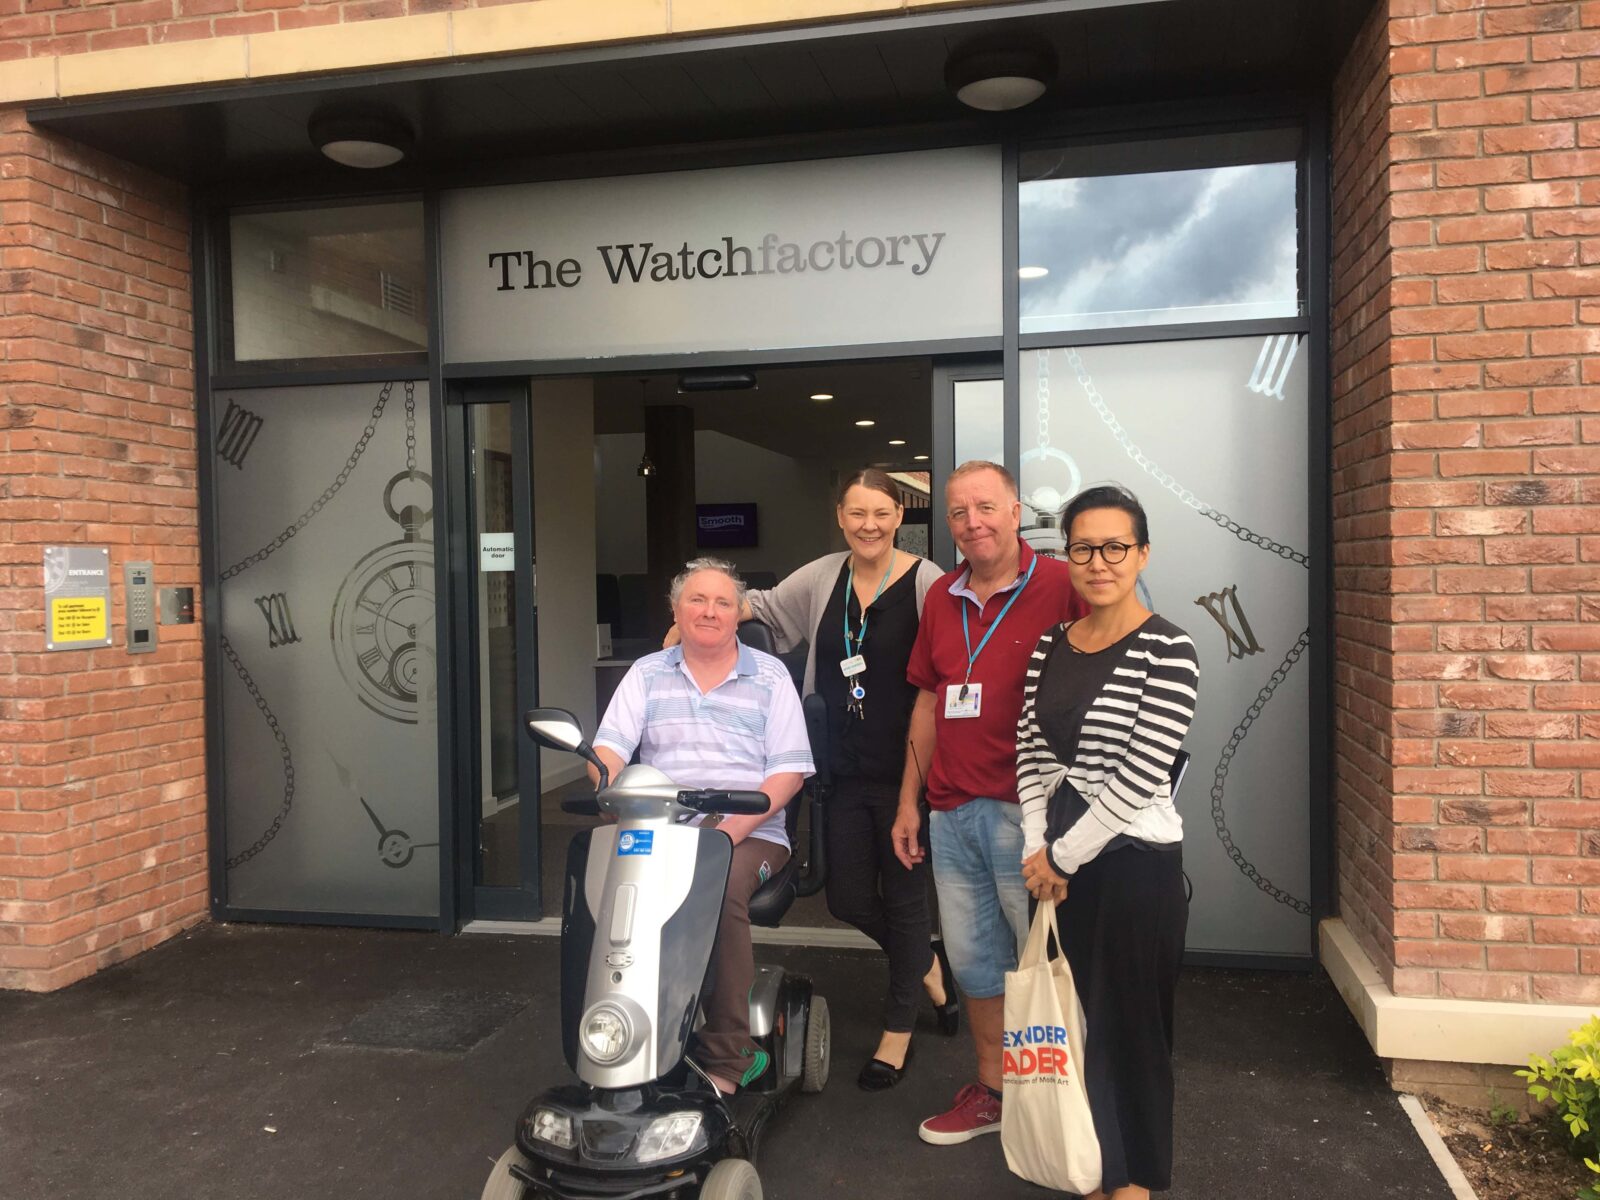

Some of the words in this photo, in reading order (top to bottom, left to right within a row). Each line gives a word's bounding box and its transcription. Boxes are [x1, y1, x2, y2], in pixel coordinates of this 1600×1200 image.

[488, 251, 582, 291] The
[597, 230, 946, 285] Watchfactory
[700, 515, 743, 526] Smooth
[68, 569, 105, 577] ENTRANCE
[1003, 1025, 1067, 1048] EXNDER
[1002, 1047, 1069, 1077] ADER
[1057, 1078, 1069, 1086] Art
